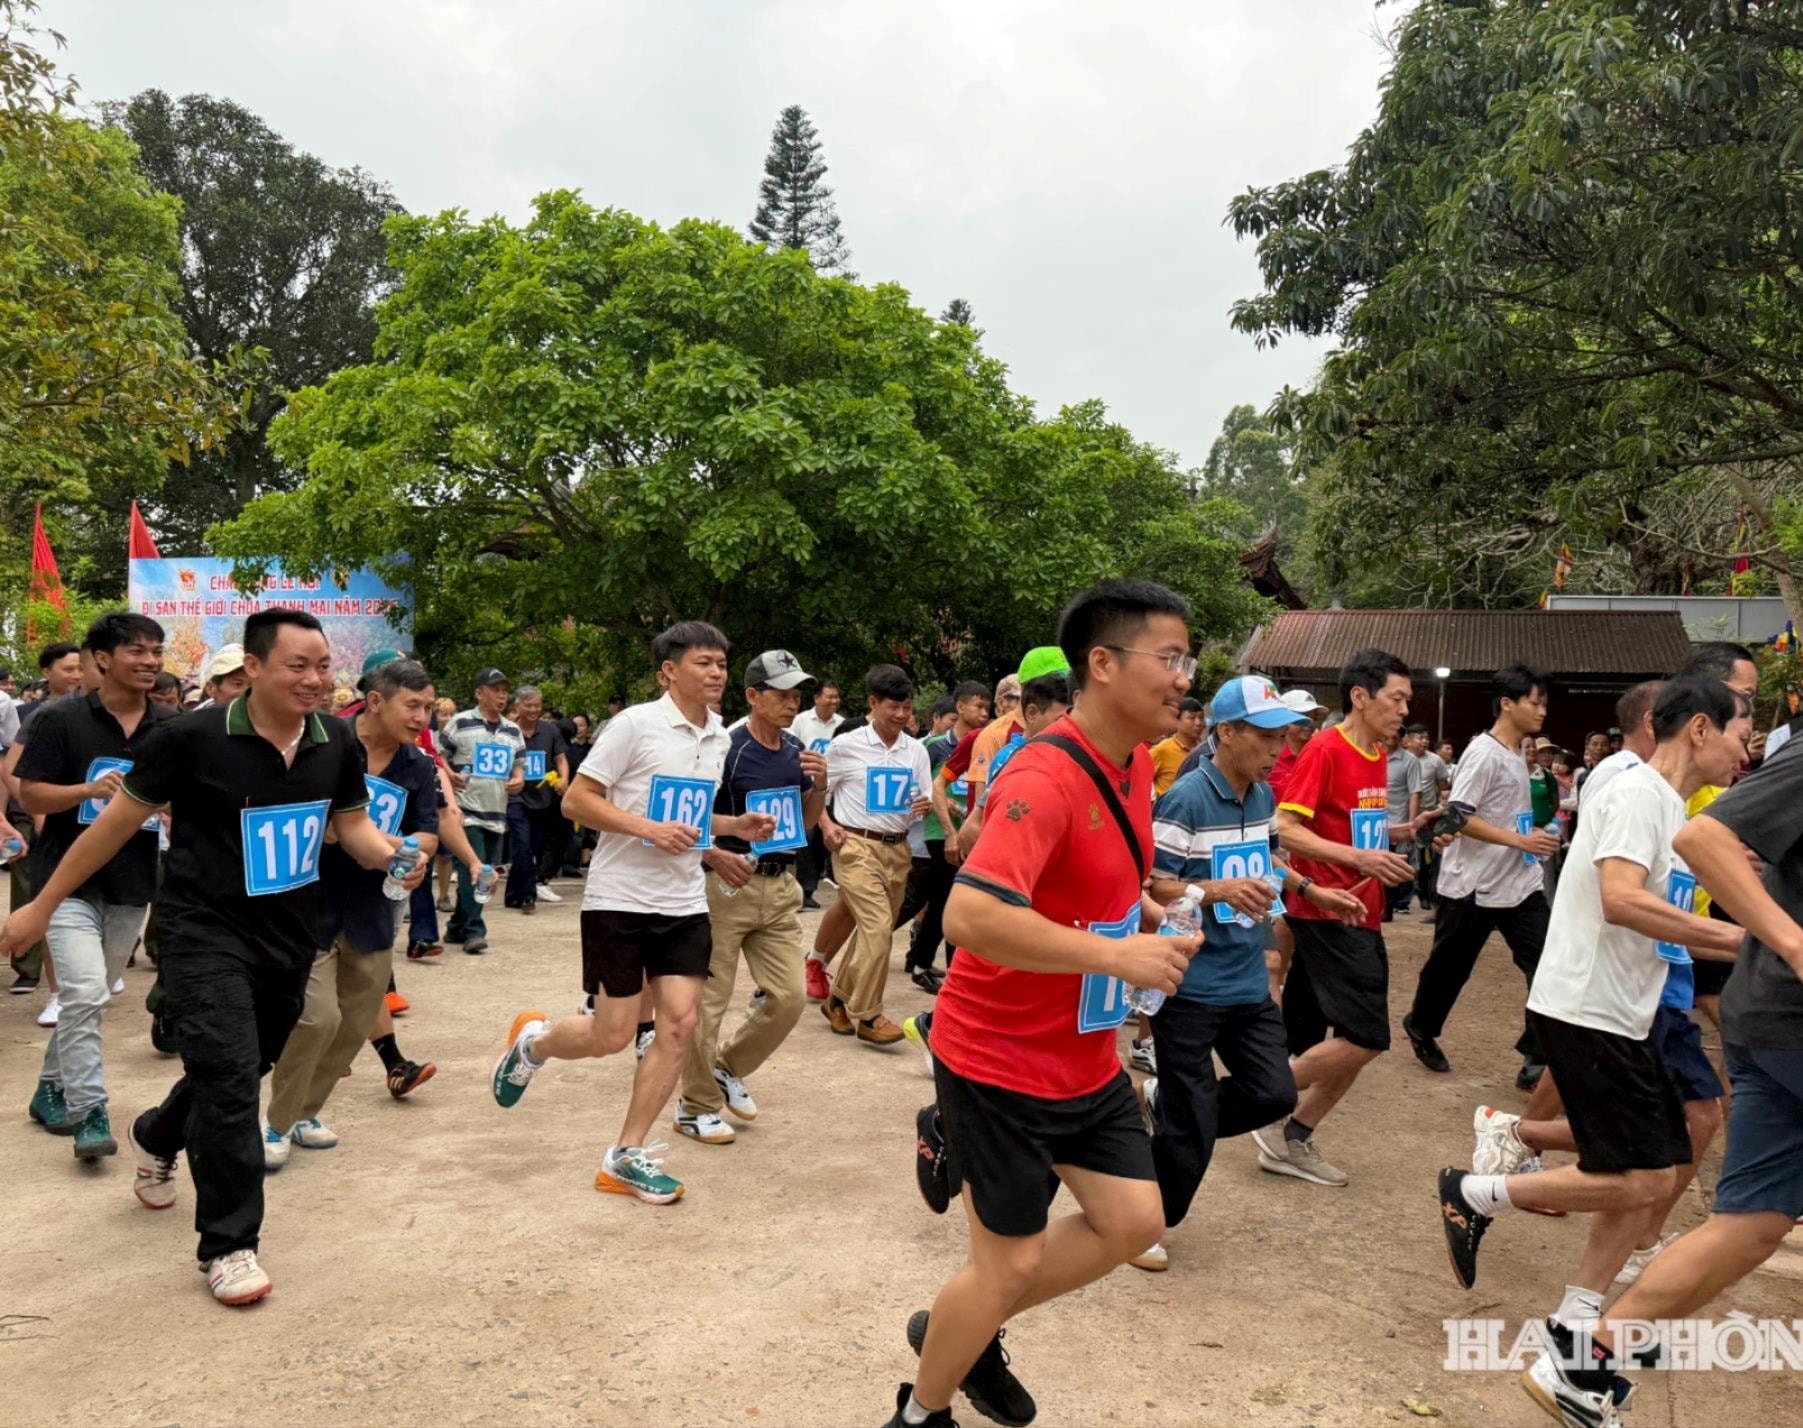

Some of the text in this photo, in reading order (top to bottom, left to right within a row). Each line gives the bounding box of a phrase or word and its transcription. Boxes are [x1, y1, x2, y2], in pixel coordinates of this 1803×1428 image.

[310, 600, 331, 616] MAI
[478, 747, 508, 774] 33
[366, 785, 398, 836] 3
[873, 773, 908, 807] 17
[660, 786, 707, 837] 162
[257, 814, 320, 880] 112
